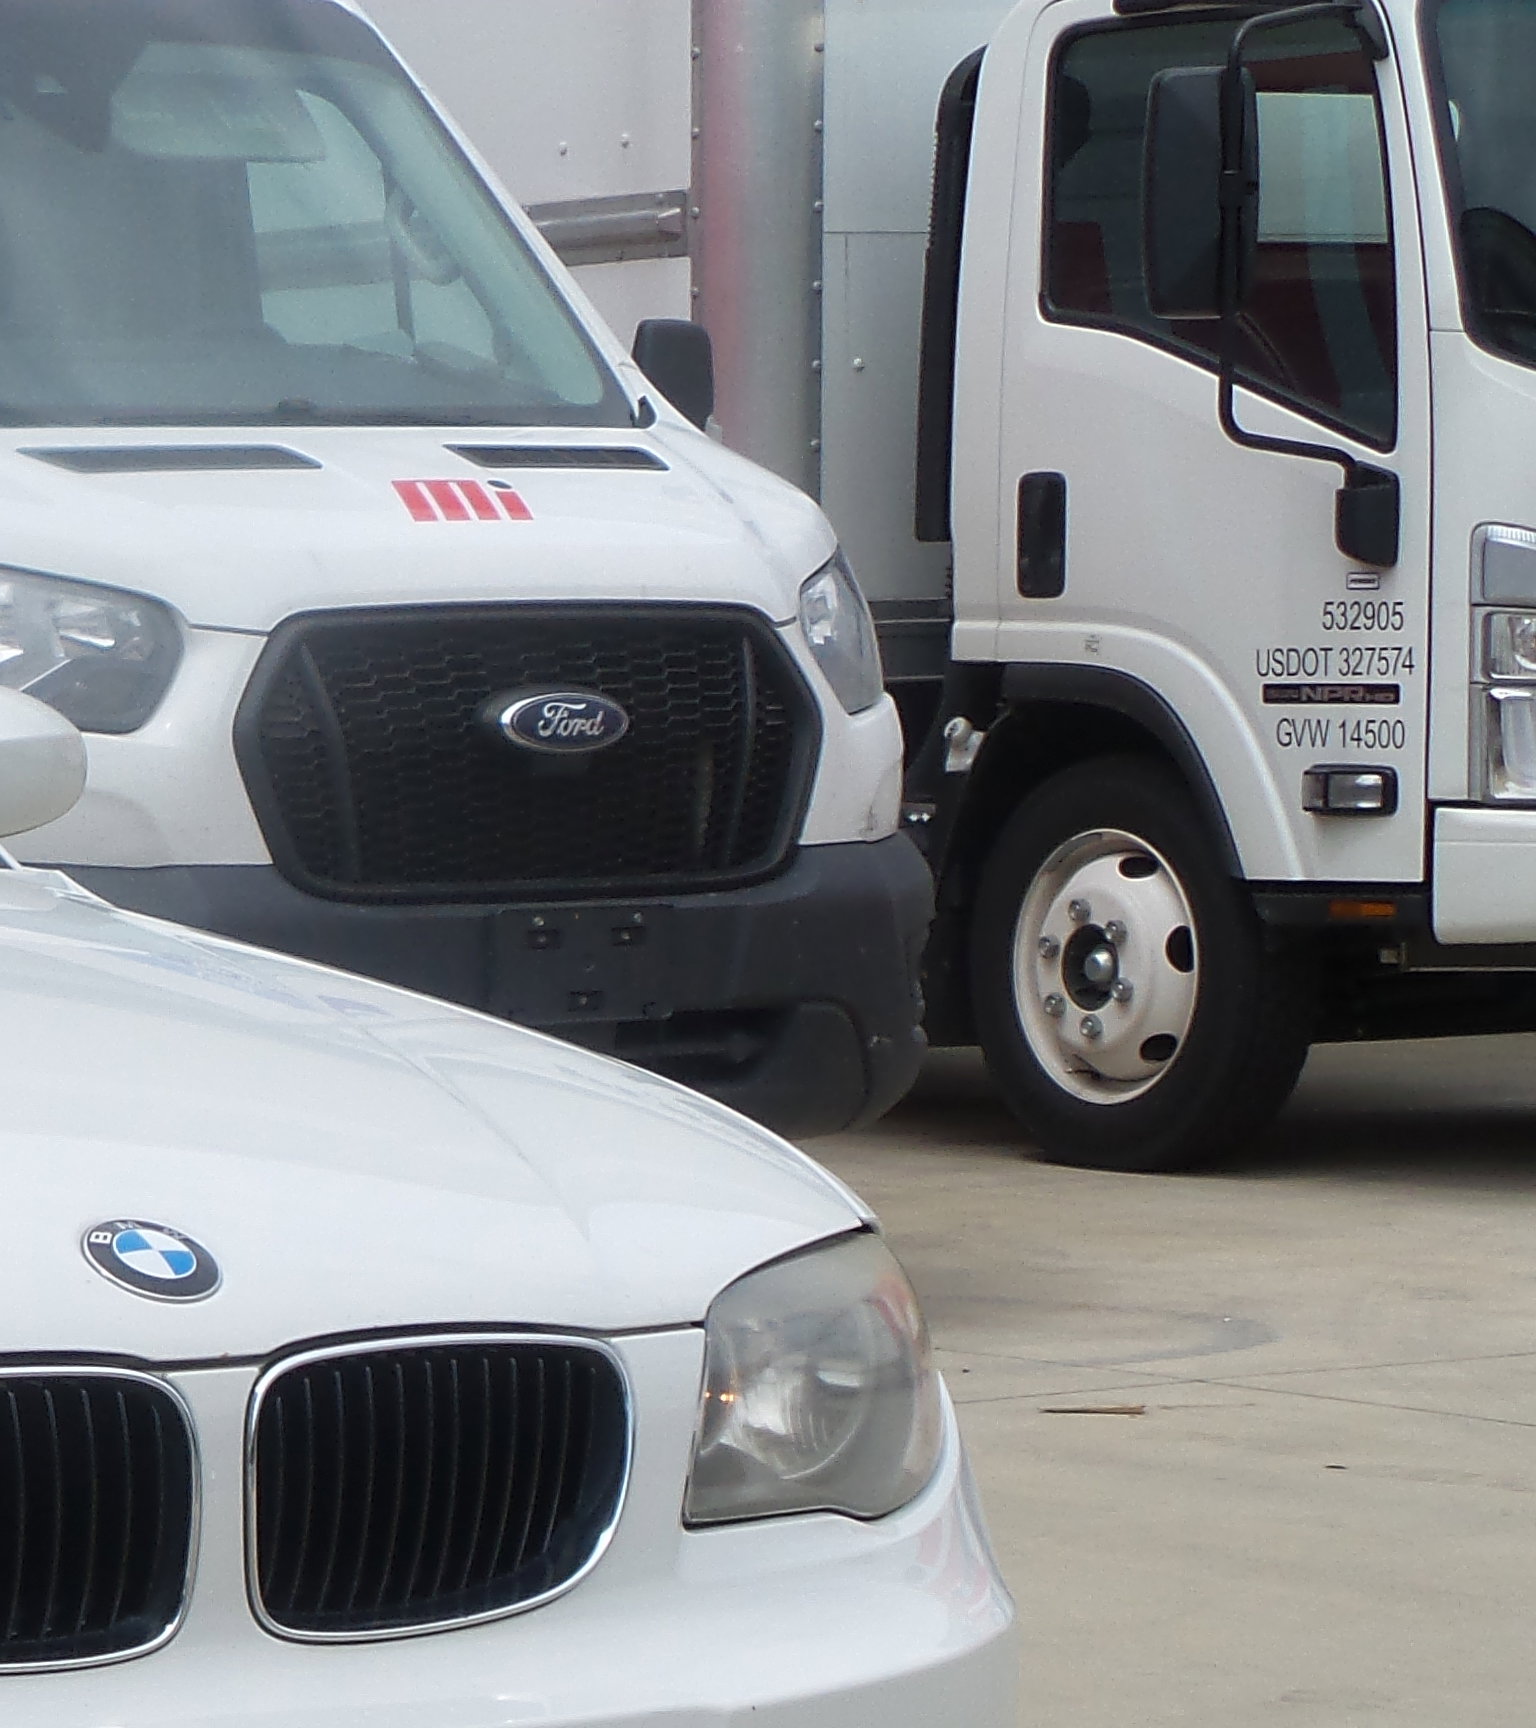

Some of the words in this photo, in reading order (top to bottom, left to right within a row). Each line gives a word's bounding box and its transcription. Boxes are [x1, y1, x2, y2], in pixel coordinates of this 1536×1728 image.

[1322, 601, 1404, 631] 532905
[1256, 648, 1333, 677] USDOT
[1338, 647, 1415, 677] 327574
[538, 702, 605, 737] Ford
[1276, 718, 1330, 748] GVW
[1338, 719, 1406, 749] 14500
